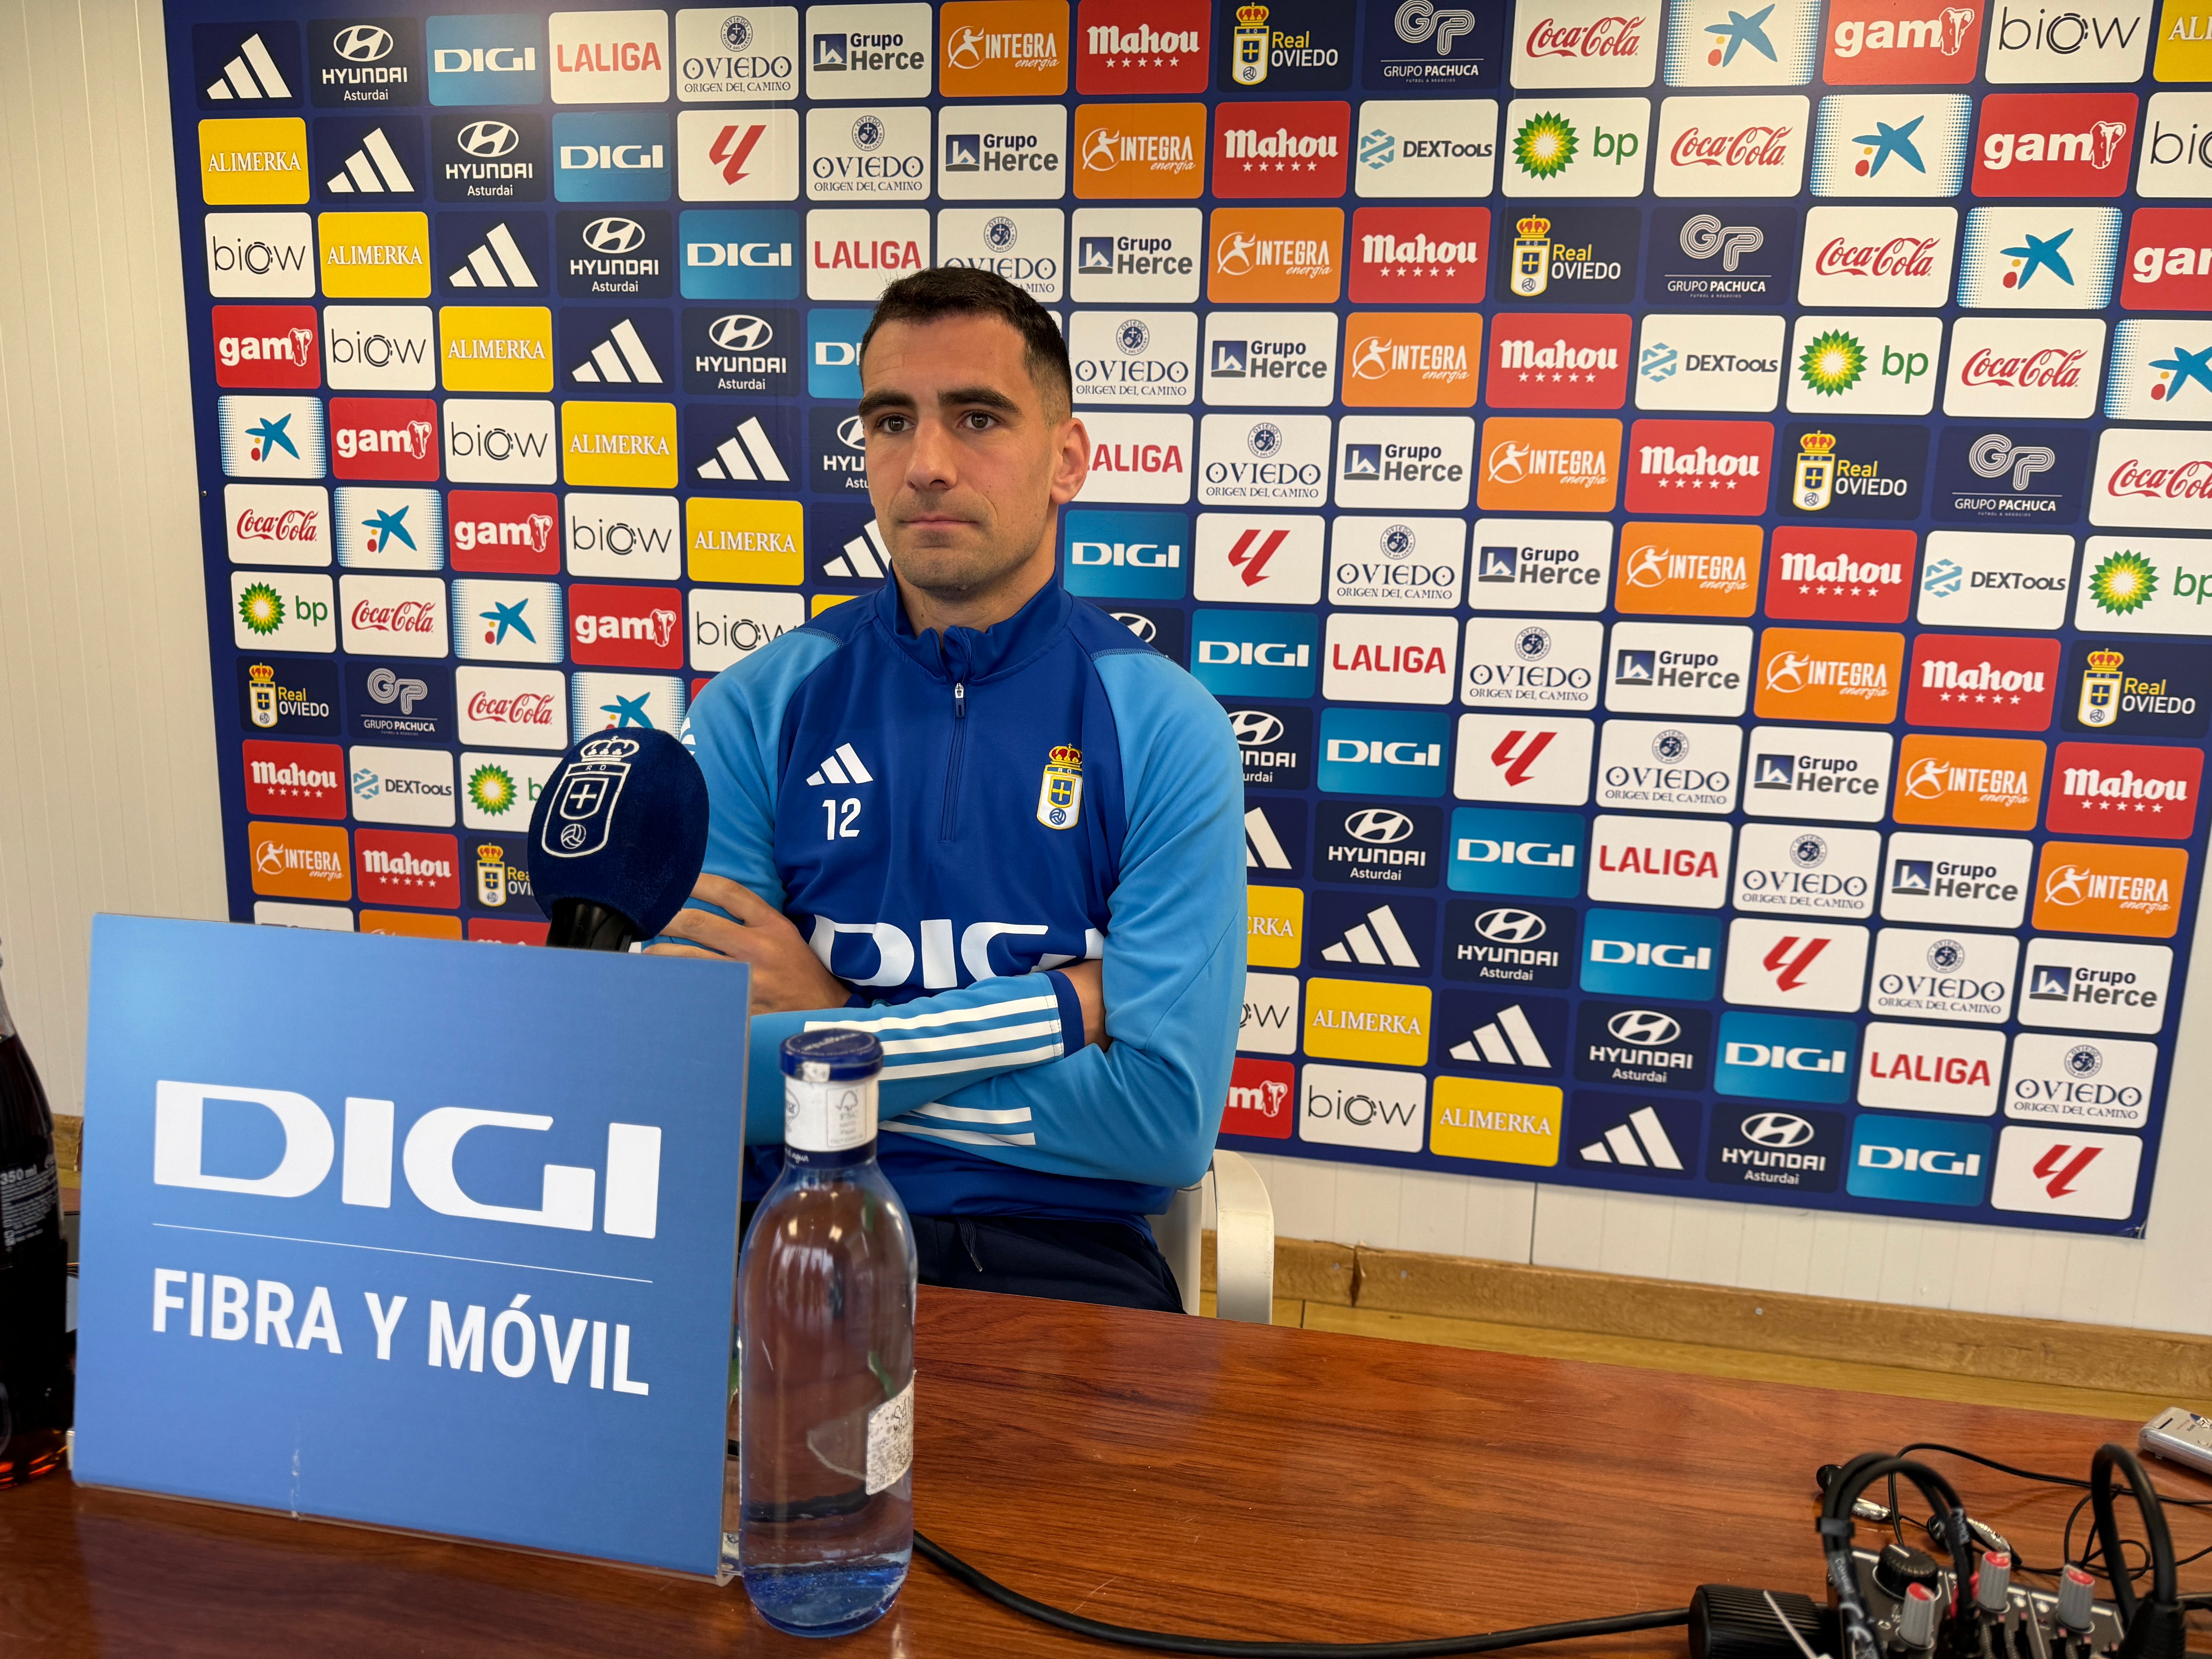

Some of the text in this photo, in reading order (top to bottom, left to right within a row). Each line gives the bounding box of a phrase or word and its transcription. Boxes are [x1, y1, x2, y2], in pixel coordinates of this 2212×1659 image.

[850, 33, 903, 51] Grupo
[985, 32, 1057, 59] INTEGRA
[1087, 23, 1200, 55] Mahou
[1271, 31, 1310, 49] Real
[1526, 17, 1644, 58] Coca-Cola
[1834, 15, 1941, 58] gam
[434, 47, 536, 73] DIGI
[558, 42, 661, 73] LALIGA
[682, 56, 792, 80] OVIEDO
[851, 50, 924, 71] Herce
[1271, 48, 1338, 67] OVIEDO
[321, 67, 408, 84] HYUNDAI
[1383, 64, 1479, 77] GRUPO PACHUCA
[343, 88, 389, 101] Asturdai
[983, 133, 1037, 151] Grupo
[1120, 136, 1193, 161] INTEGRA
[1224, 128, 1339, 158] Mahou
[1594, 127, 1638, 165] bp
[1670, 127, 1791, 167] Coca-Cola
[1983, 129, 2092, 171] gam
[207, 151, 302, 172] ALIMERKA
[560, 144, 663, 169] DIGI
[812, 156, 924, 179] OVIEDO
[984, 151, 1058, 172] Herce
[445, 163, 533, 180] HYUNDAI
[467, 184, 513, 196] Asturdai
[814, 181, 922, 192] ORIGEN DEL CAMINO
[327, 246, 423, 265] ALIMERKA
[687, 243, 792, 266] DIGI
[815, 240, 922, 269] LALIGA
[1117, 236, 1172, 255] Grupo
[1255, 240, 1330, 266] INTEGRA
[1361, 233, 1478, 263] Mahou
[1552, 244, 1592, 261] Real
[570, 259, 659, 275] HYUNDAI
[1117, 254, 1193, 275] Herce
[1551, 262, 1621, 280] OVIEDO
[591, 280, 639, 292] Asturdai
[1667, 280, 1766, 292] GRUPO PACHUCA
[218, 334, 292, 366] gam
[448, 339, 546, 359] ALIMERKA
[1250, 340, 1307, 359] Grupo
[1391, 345, 1467, 370] INTEGRA
[1500, 339, 1619, 369] Mahou
[696, 356, 786, 373] HYUNDAI
[1074, 360, 1190, 383] OVIEDO
[1250, 357, 1328, 379] Herce
[1883, 345, 1929, 384] bp
[1961, 347, 2086, 388] Coca-Cola
[1075, 385, 1187, 396] ORIGEN DEL CAMINO
[336, 427, 410, 458] gam
[570, 434, 670, 455] ALIMERKA
[1385, 443, 1442, 462] Grupo
[1087, 443, 1184, 473] ALIGA
[1529, 449, 1606, 475] INTEGRA
[1837, 459, 1878, 477] Real
[1205, 462, 1322, 486] OVIEDO
[1384, 461, 1463, 483] Herce
[1835, 477, 1908, 496] OVIEDO
[1954, 498, 2056, 512] GRUPO PACHUCA
[235, 508, 318, 542] Coca-Cola
[454, 520, 529, 551] gam
[695, 531, 796, 552] ALIMERKA
[1070, 542, 1181, 568] DIGI
[1521, 546, 1579, 565] Grupo
[1336, 563, 1455, 587] OVIEDO
[1520, 563, 1600, 586] Herce
[1336, 587, 1453, 600] ORIGEN DEL CAMINO
[295, 596, 328, 627] bp
[350, 599, 434, 633] Coca-Cola
[575, 615, 651, 644] gam
[1197, 640, 1310, 668] DIGI
[1333, 644, 1446, 675] LALIGA
[1470, 664, 1591, 689] OVIEDO
[1921, 660, 2045, 692] Mahou
[2123, 677, 2167, 696] Real
[278, 686, 307, 702] Real
[2121, 695, 2197, 715] OVIEDO
[279, 701, 330, 717] OVIEDO
[468, 690, 553, 725] Coca-Cola
[364, 719, 435, 732] GRUPO PACHUCA
[1326, 739, 1441, 767] DIGI
[250, 761, 338, 788] Mahou
[1606, 766, 1729, 792] OVIEDO
[1947, 767, 2028, 795] INTEGRA
[2063, 768, 2188, 801] Mahou
[822, 798, 861, 841] 12
[284, 848, 341, 872] INTEGRA
[362, 850, 452, 878] Mahou
[1328, 845, 1426, 866] HYUNDAI
[1457, 838, 1574, 867] DIGI
[1601, 845, 1717, 878] LALIGA
[1349, 867, 1402, 881] Asturdai
[1936, 861, 1997, 881] Grupo
[1934, 878, 2018, 902] Herce
[2087, 874, 2169, 902] INTEGRA
[1458, 945, 1558, 967] HYUNDAI
[1878, 974, 2006, 1002] OVIEDO
[2075, 967, 2137, 987] Grupo
[2072, 983, 2158, 1008] Herce
[1312, 1009, 1421, 1035] ALIMERKA
[1590, 1046, 1692, 1069] HYUNDAI
[1725, 1042, 1846, 1073] DIGI
[1870, 1052, 1991, 1087] LALIGA
[2014, 1078, 2143, 1108] OVIEDO
[1440, 1108, 1551, 1135] ALIMERKA
[153, 1079, 662, 1239] DIGI
[1722, 1147, 1826, 1171] HYUNDAI
[1858, 1145, 1981, 1176] DIGI
[1744, 1170, 1799, 1185] Asturdai
[152, 1267, 649, 1396] FIBRA Y MÓVIL
